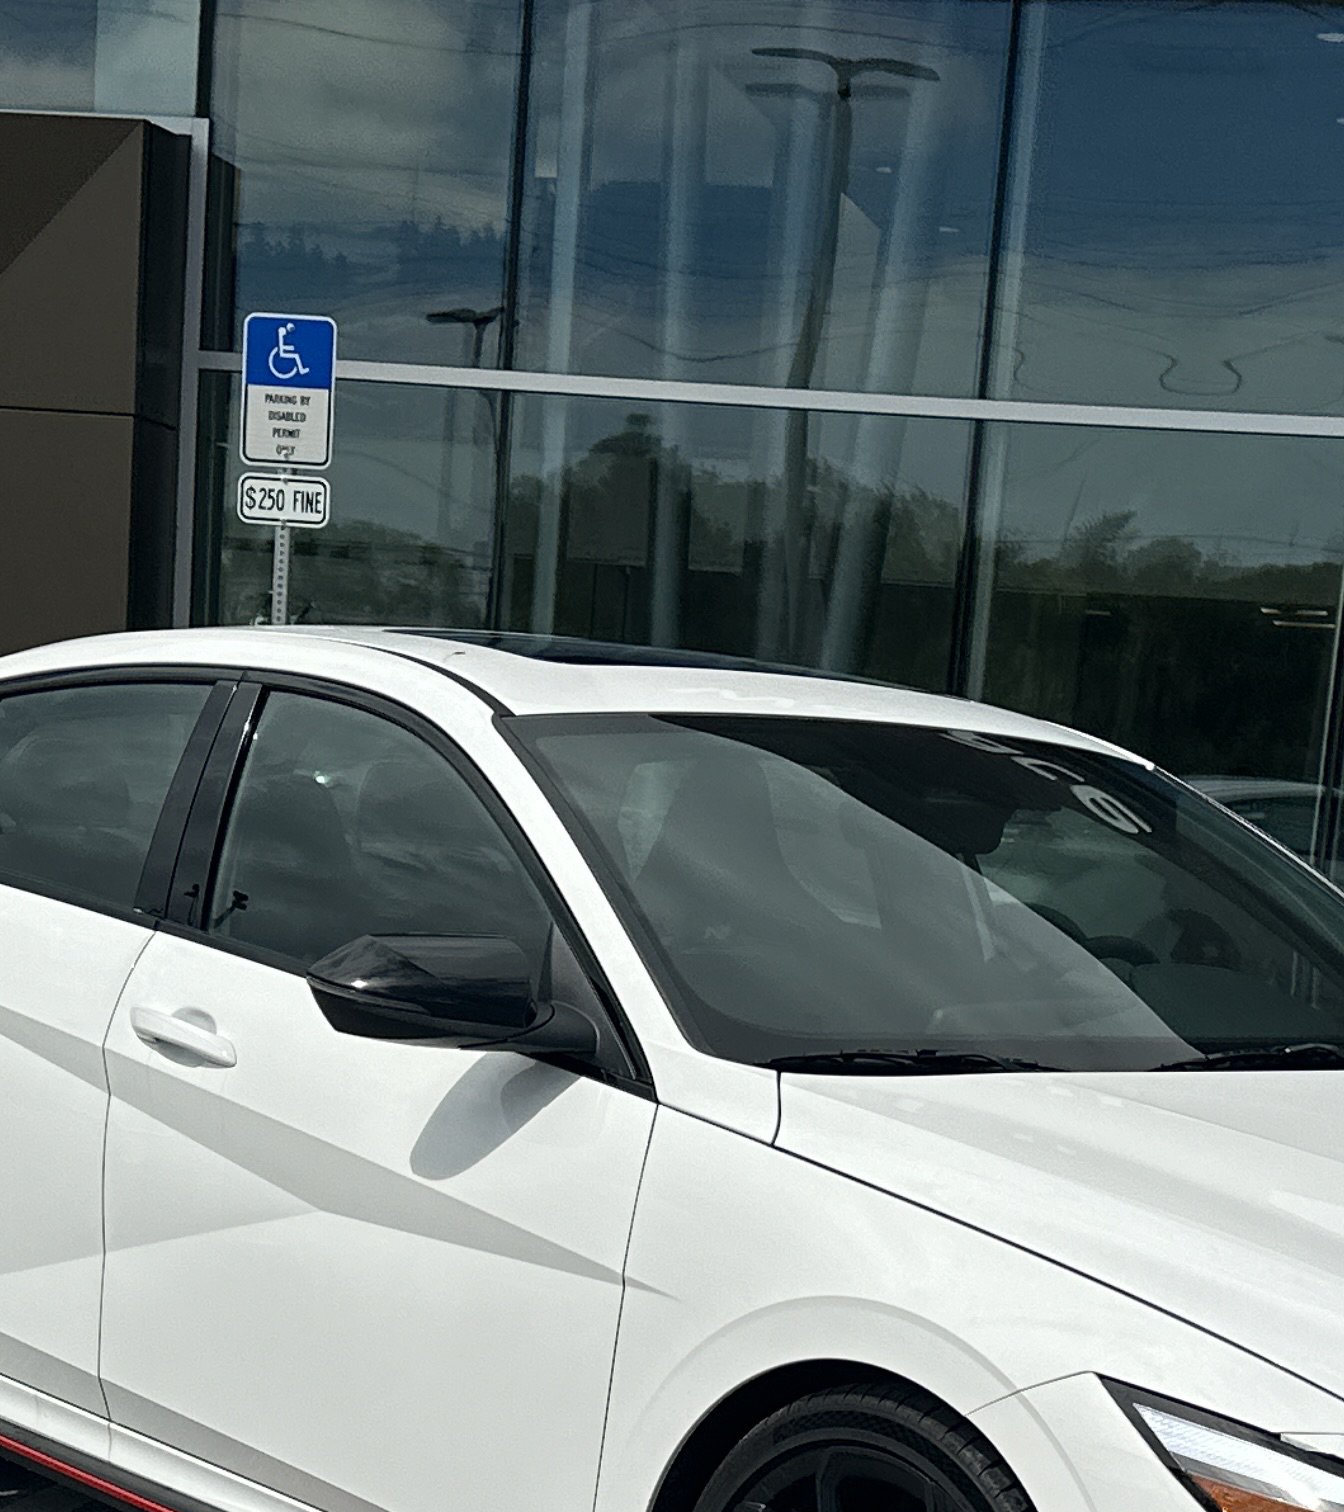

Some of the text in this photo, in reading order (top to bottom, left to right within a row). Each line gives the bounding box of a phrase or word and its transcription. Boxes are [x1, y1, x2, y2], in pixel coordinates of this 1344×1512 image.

[265, 393, 311, 406] PARKING BY
[268, 410, 306, 422] DISABLED
[272, 427, 301, 439] PERMIT
[245, 485, 322, 514] $250 FINE
